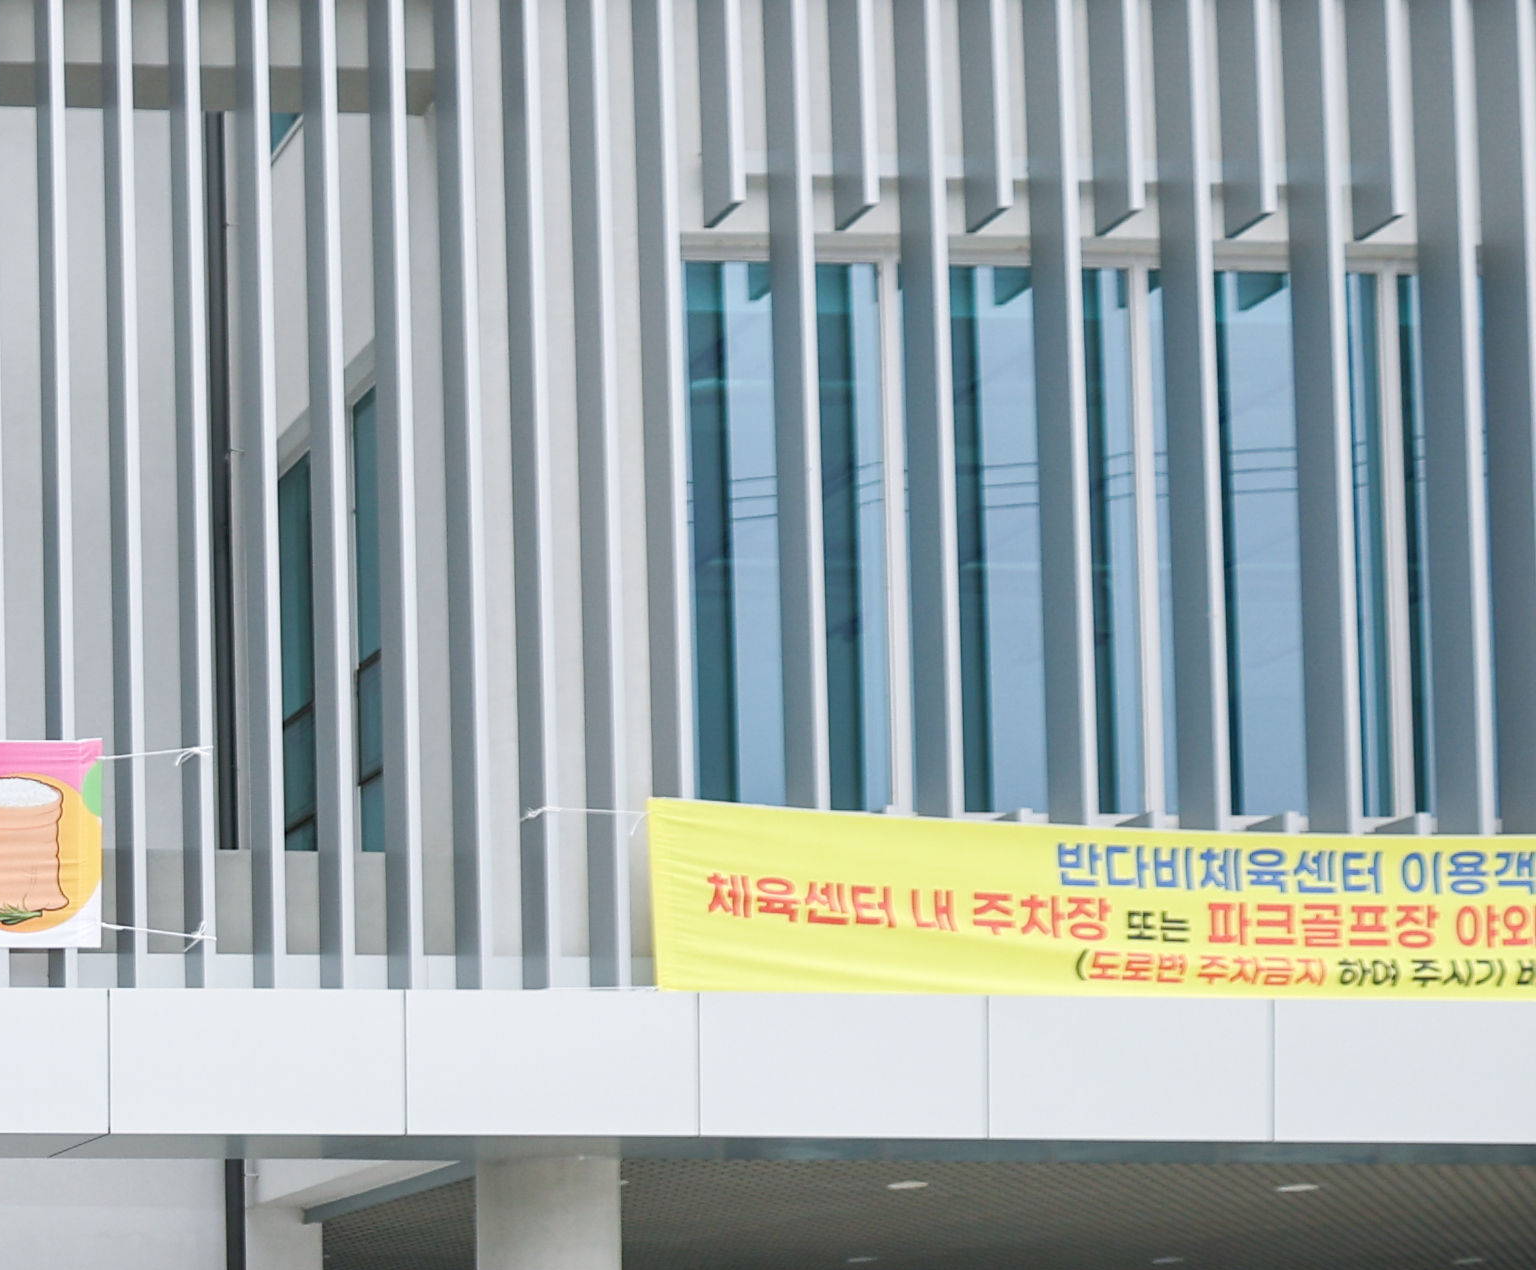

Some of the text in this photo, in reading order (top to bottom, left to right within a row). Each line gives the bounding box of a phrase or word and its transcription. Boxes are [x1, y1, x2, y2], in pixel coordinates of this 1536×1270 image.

[1057, 842, 1536, 895] 반다비체육센터 이용객
[706, 870, 898, 929] 체육센터
[911, 888, 960, 932] 내
[972, 891, 1112, 942] 주차장
[1126, 909, 1190, 943] 또는
[1207, 900, 1440, 949] 파크골프장
[1075, 948, 1189, 985] (도로변
[1197, 954, 1328, 987] 주차금지
[1410, 957, 1507, 987] 주시기
